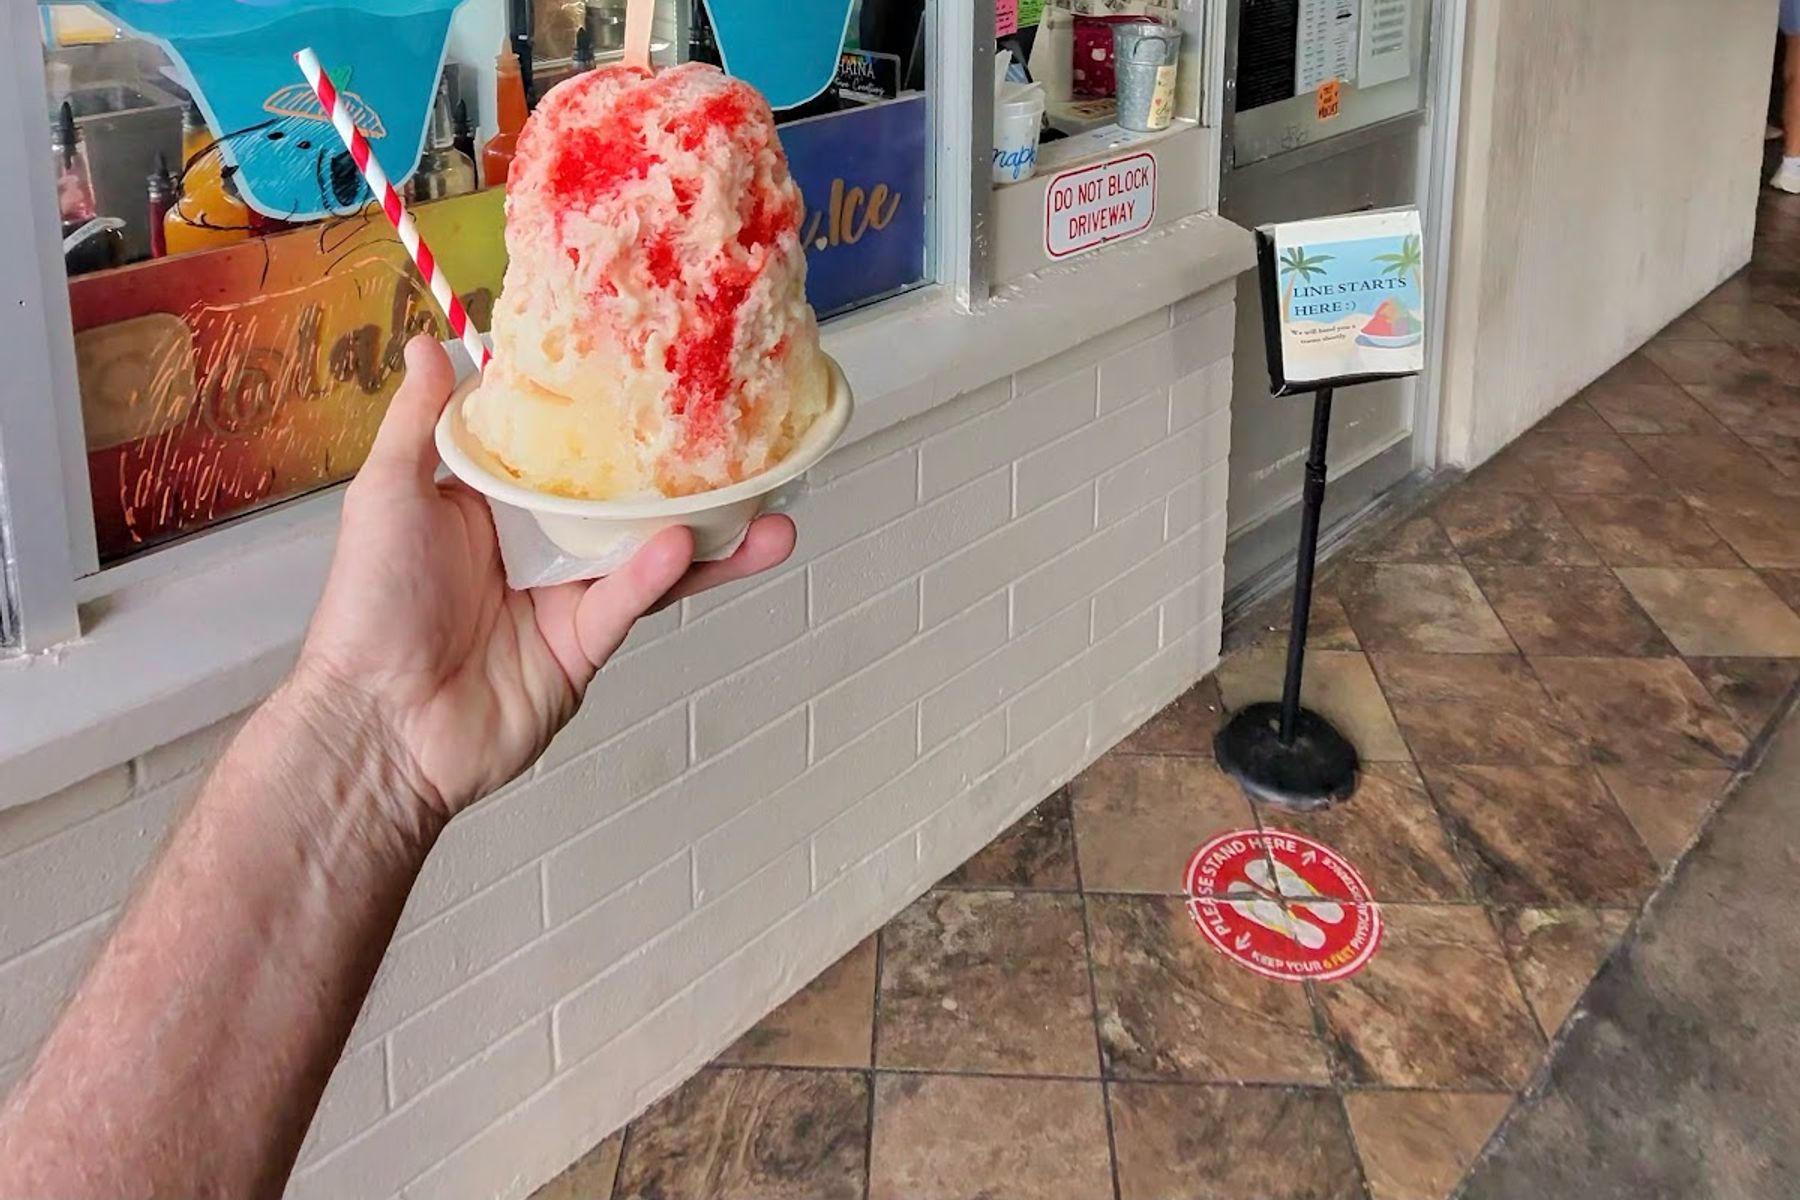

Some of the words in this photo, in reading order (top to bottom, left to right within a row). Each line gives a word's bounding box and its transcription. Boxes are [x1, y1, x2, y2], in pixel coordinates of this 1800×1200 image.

[1054, 187, 1073, 213] DO
[1078, 178, 1104, 205] NOT
[1108, 165, 1150, 196] BLOCK
[1069, 200, 1136, 239] DRIVEWAY
[1293, 284, 1335, 298] LINE
[1338, 277, 1407, 296] STARTS
[1295, 301, 1342, 317] HERE
[1203, 839, 1247, 878] STAND
[1248, 836, 1297, 853] HERE
[1198, 875, 1232, 936] PLEASE
[1252, 951, 1284, 969] KEEP
[1286, 960, 1323, 973] YOUR
[1323, 959, 1332, 969] 6
[1332, 945, 1356, 966] FEET
